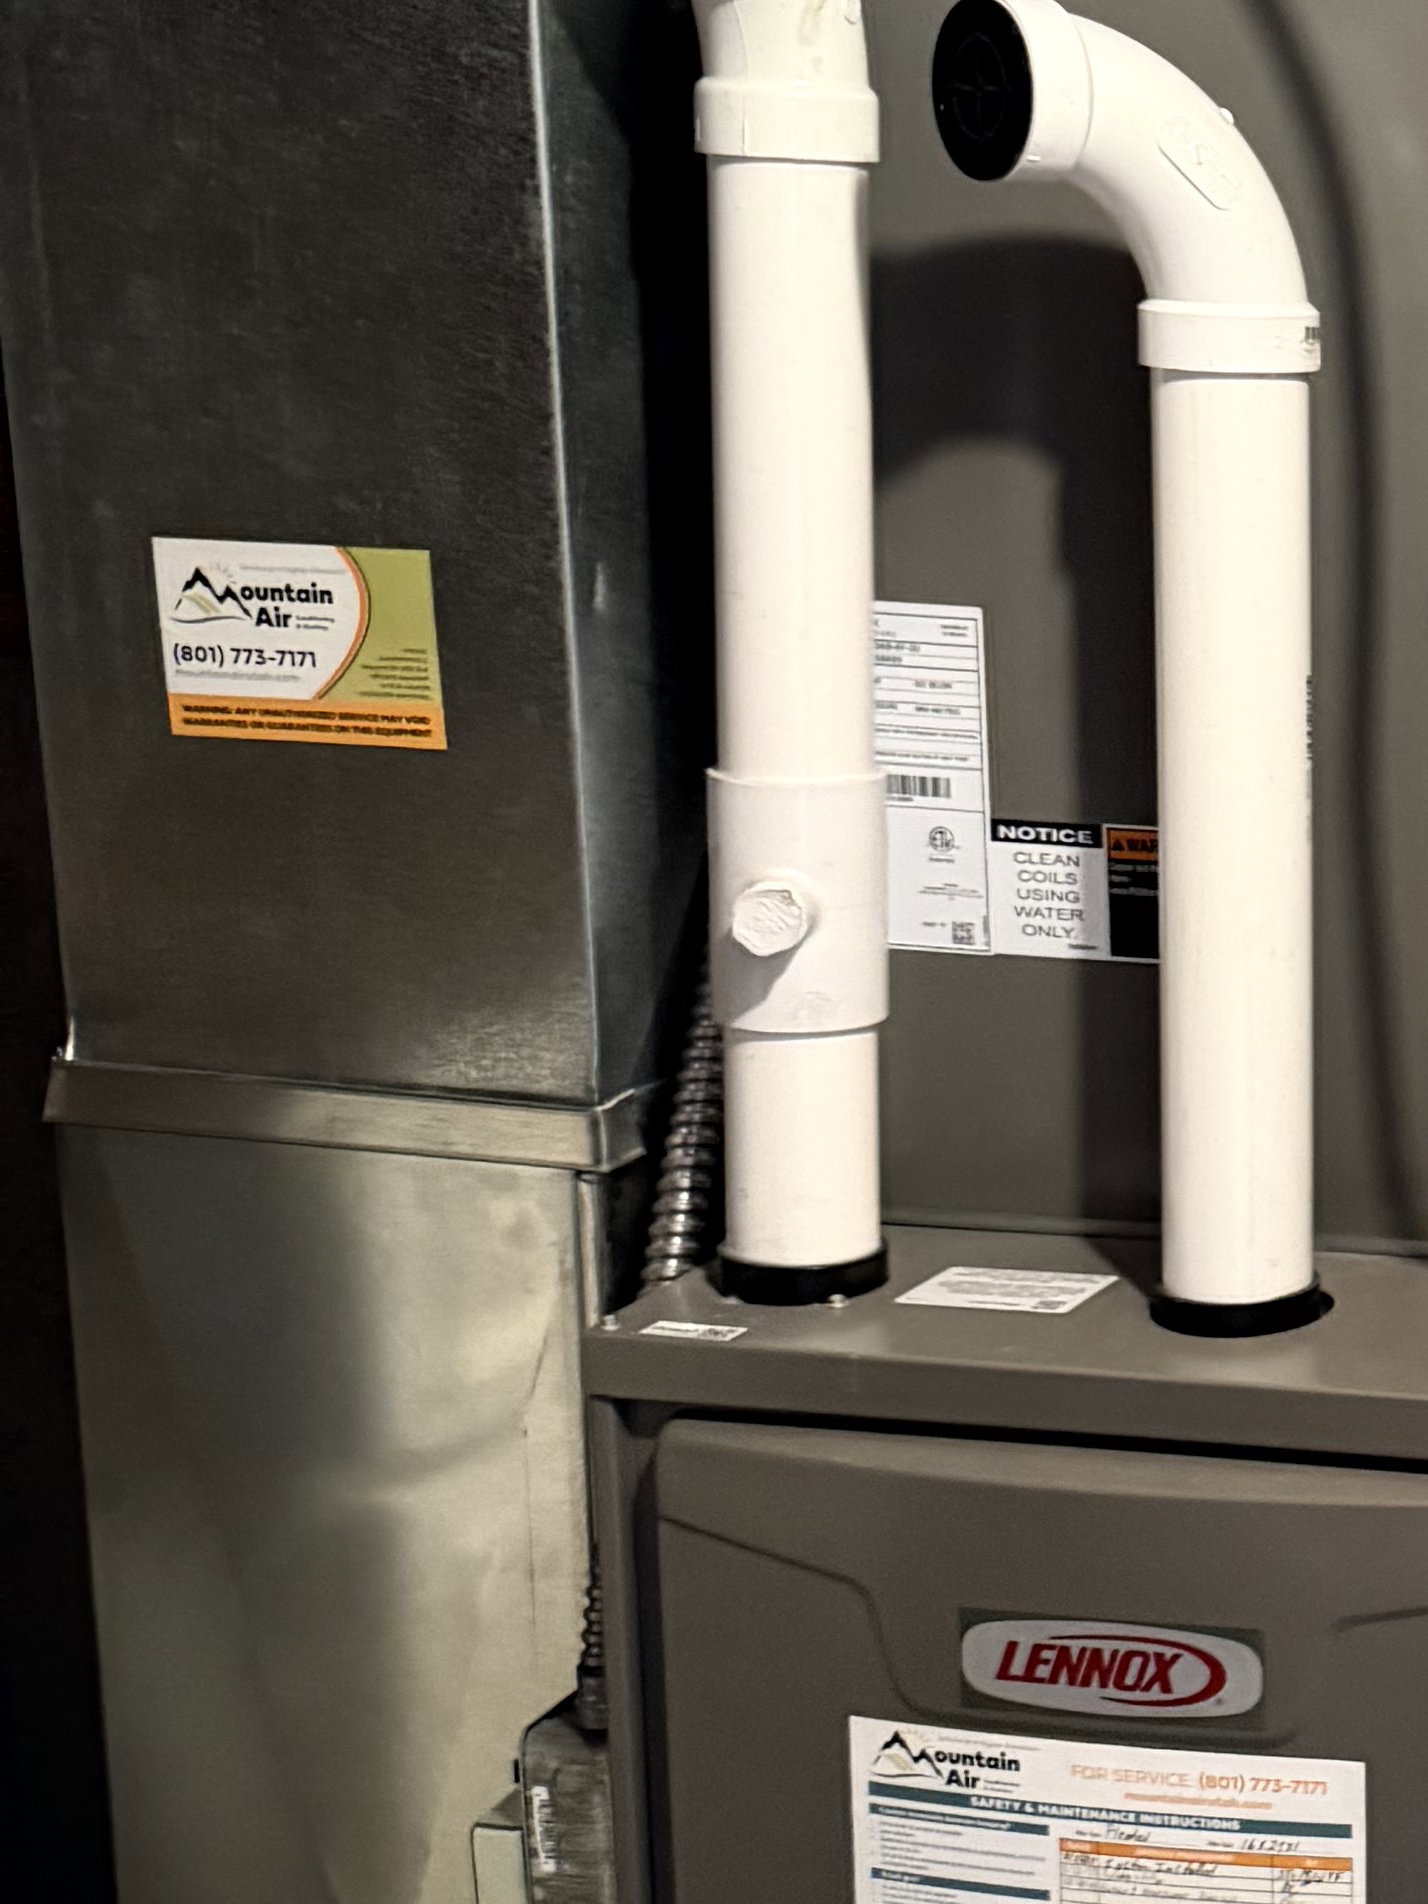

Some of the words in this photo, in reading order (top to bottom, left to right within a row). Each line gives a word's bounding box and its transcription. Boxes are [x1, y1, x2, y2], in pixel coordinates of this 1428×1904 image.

[255, 607, 291, 627] Air
[173, 644, 224, 667] (801)
[230, 647, 317, 667] 773-7171
[997, 824, 1094, 844] NOTICE
[1013, 851, 1080, 868] CLEAN
[1017, 869, 1078, 885] COILS
[1016, 888, 1081, 904] USING
[1014, 905, 1084, 922] WATER
[995, 1640, 1183, 1694] LENNOX
[945, 1770, 980, 1788] Air
[1071, 1765, 1108, 1782] FOR
[1199, 1772, 1244, 1794] (801)
[1251, 1778, 1328, 1795] 773-7171
[970, 1796, 1020, 1812] SAFETY
[1025, 1802, 1034, 1813] &
[1038, 1803, 1136, 1823] MAINTENANCE
[1140, 1813, 1240, 1831] INSTRUCTIONS
